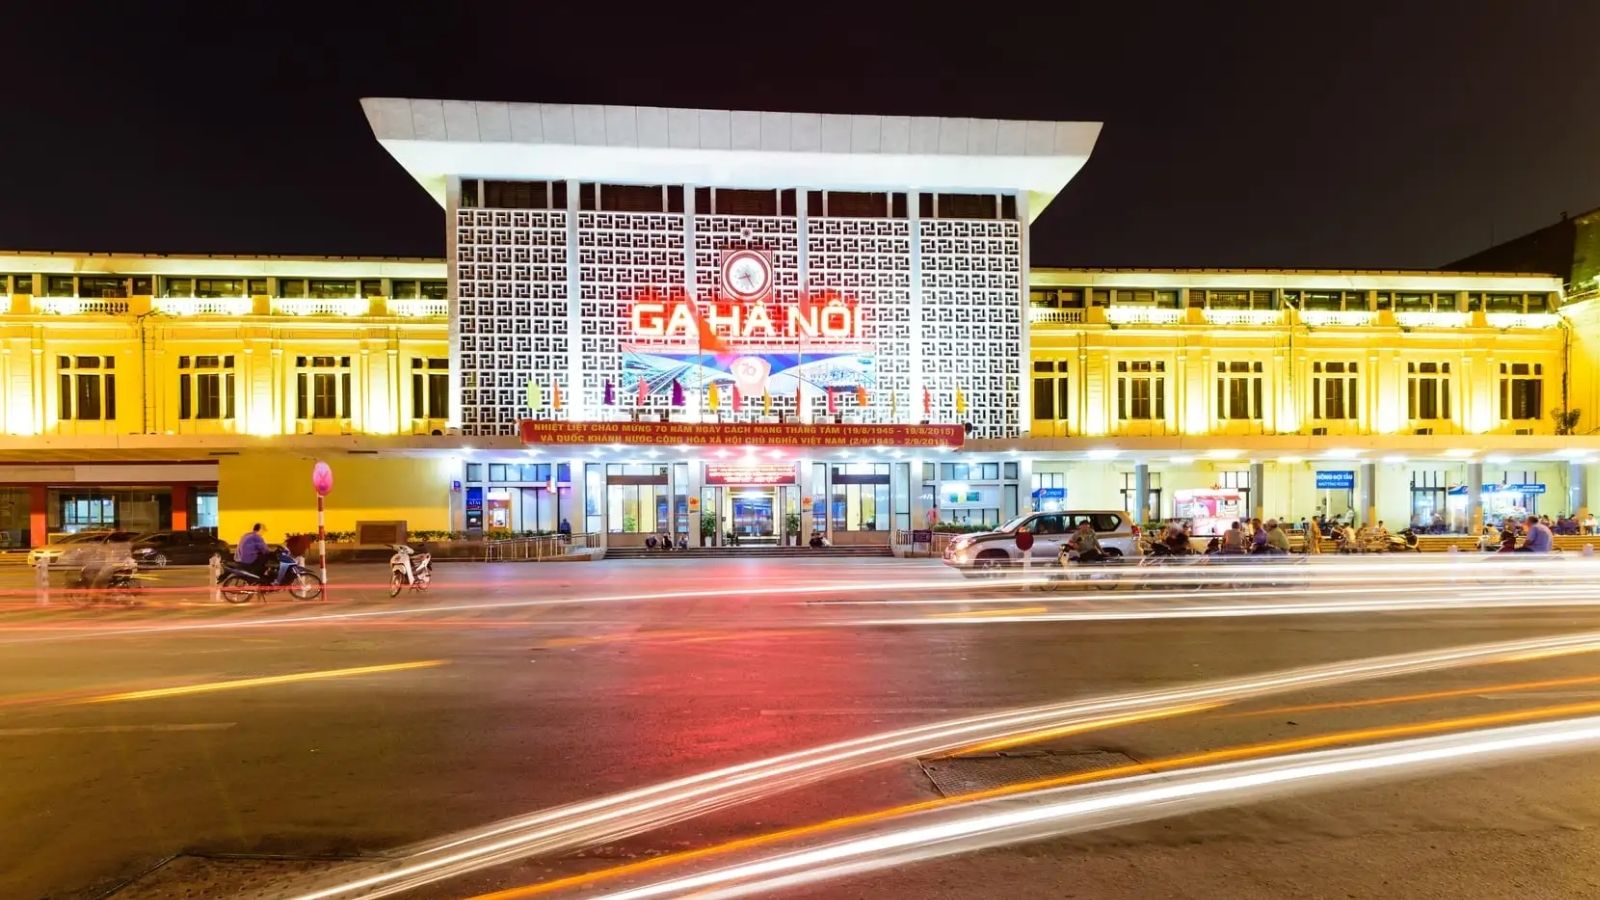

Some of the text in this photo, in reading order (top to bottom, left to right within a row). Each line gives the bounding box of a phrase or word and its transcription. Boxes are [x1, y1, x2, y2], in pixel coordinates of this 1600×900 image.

[633, 303, 700, 337] GA
[706, 300, 777, 338] HÀ
[534, 423, 563, 432] NHIỆT
[567, 423, 588, 433] LIỆT
[591, 423, 619, 432] CHÀO
[656, 425, 667, 433] 70
[541, 433, 554, 442] VÀ
[556, 433, 585, 443] QUỐC
[825, 437, 846, 445] NAM
